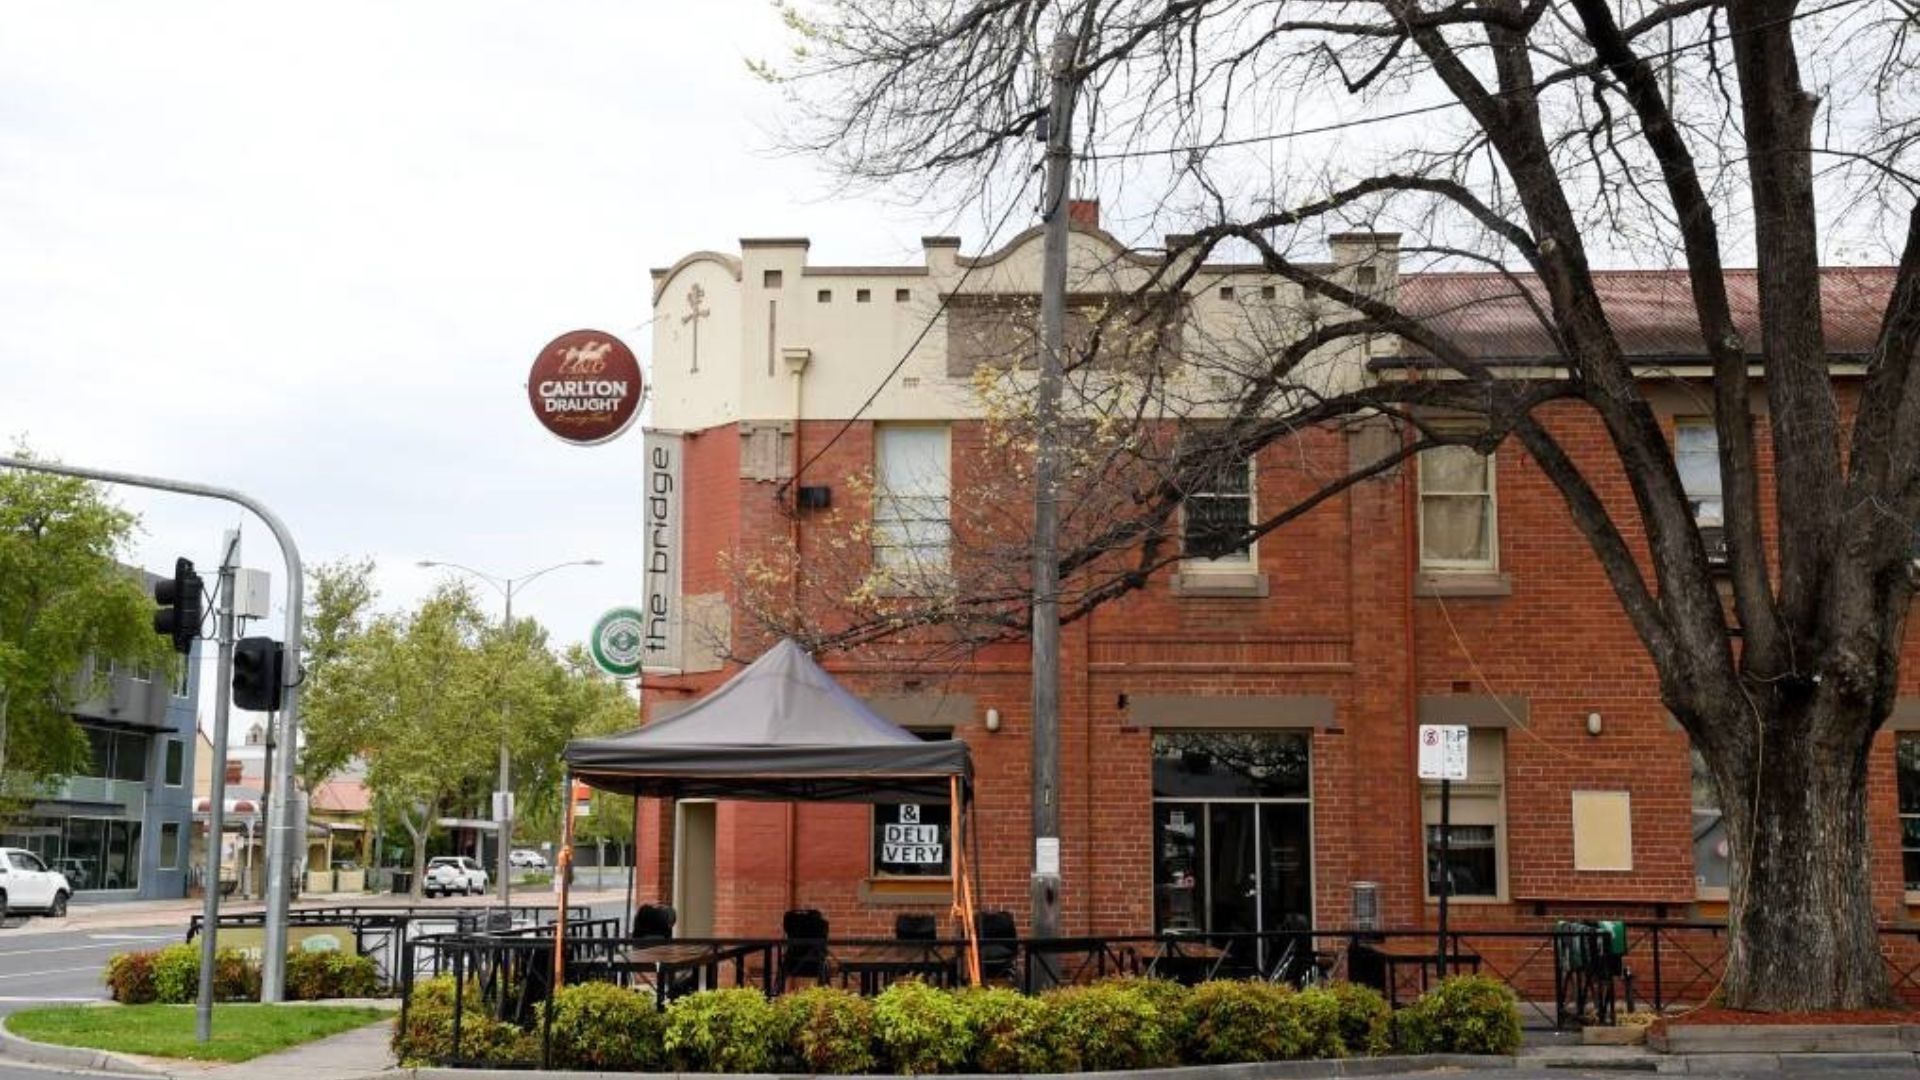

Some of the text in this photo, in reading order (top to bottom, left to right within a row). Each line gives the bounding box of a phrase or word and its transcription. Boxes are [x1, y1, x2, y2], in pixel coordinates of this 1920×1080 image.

[539, 380, 628, 397] CARLTON
[545, 397, 622, 412] DRAUGHT
[646, 447, 674, 654] the bridge
[903, 805, 917, 821] &
[888, 826, 934, 843] DELI
[885, 847, 940, 861] VERY
